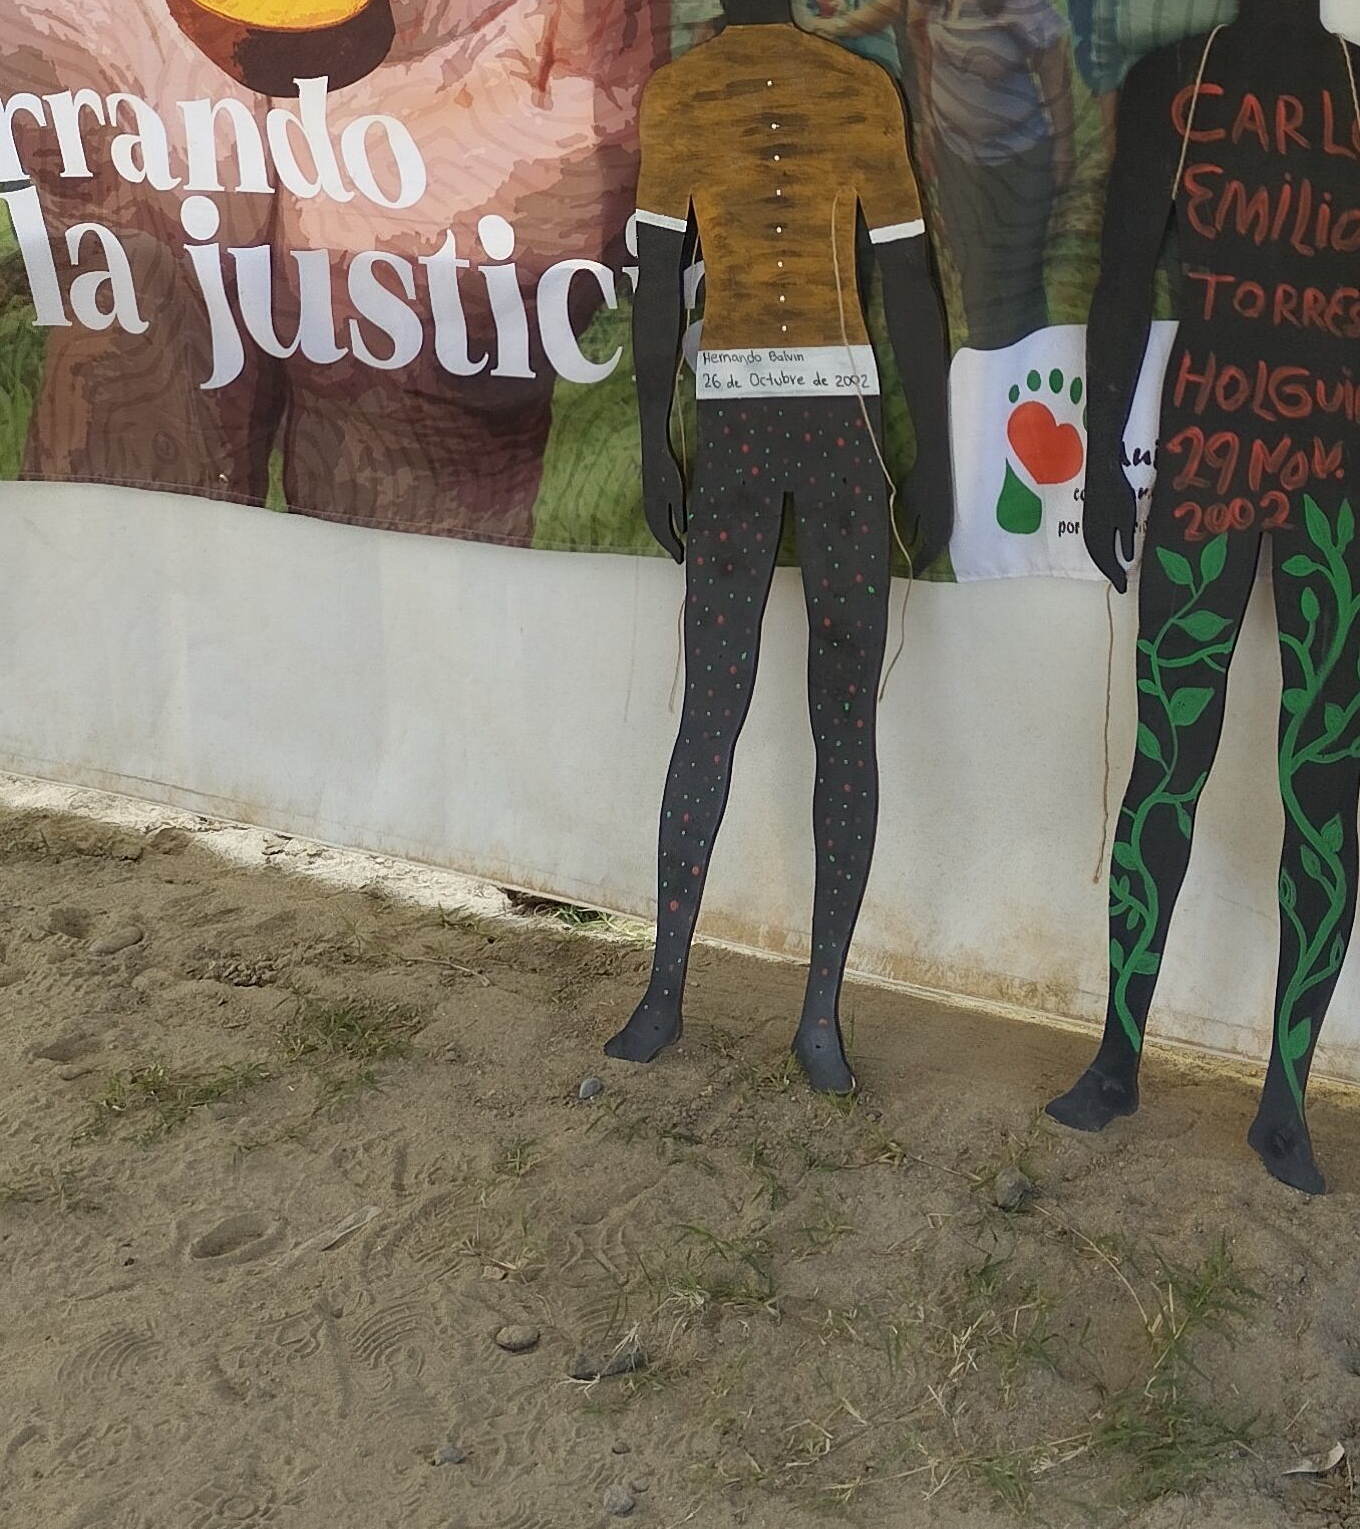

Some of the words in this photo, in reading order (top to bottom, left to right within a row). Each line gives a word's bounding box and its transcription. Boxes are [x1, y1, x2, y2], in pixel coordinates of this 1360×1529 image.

[0, 182, 149, 336] la
[702, 350, 762, 368] Hernando
[768, 350, 805, 363] Balvin
[702, 373, 722, 389] 26
[726, 374, 742, 389] de
[749, 371, 806, 388] Octubre
[812, 371, 829, 387] de
[1166, 426, 1241, 496] 29
[1058, 521, 1080, 537] por
[1172, 490, 1296, 542] 2002
